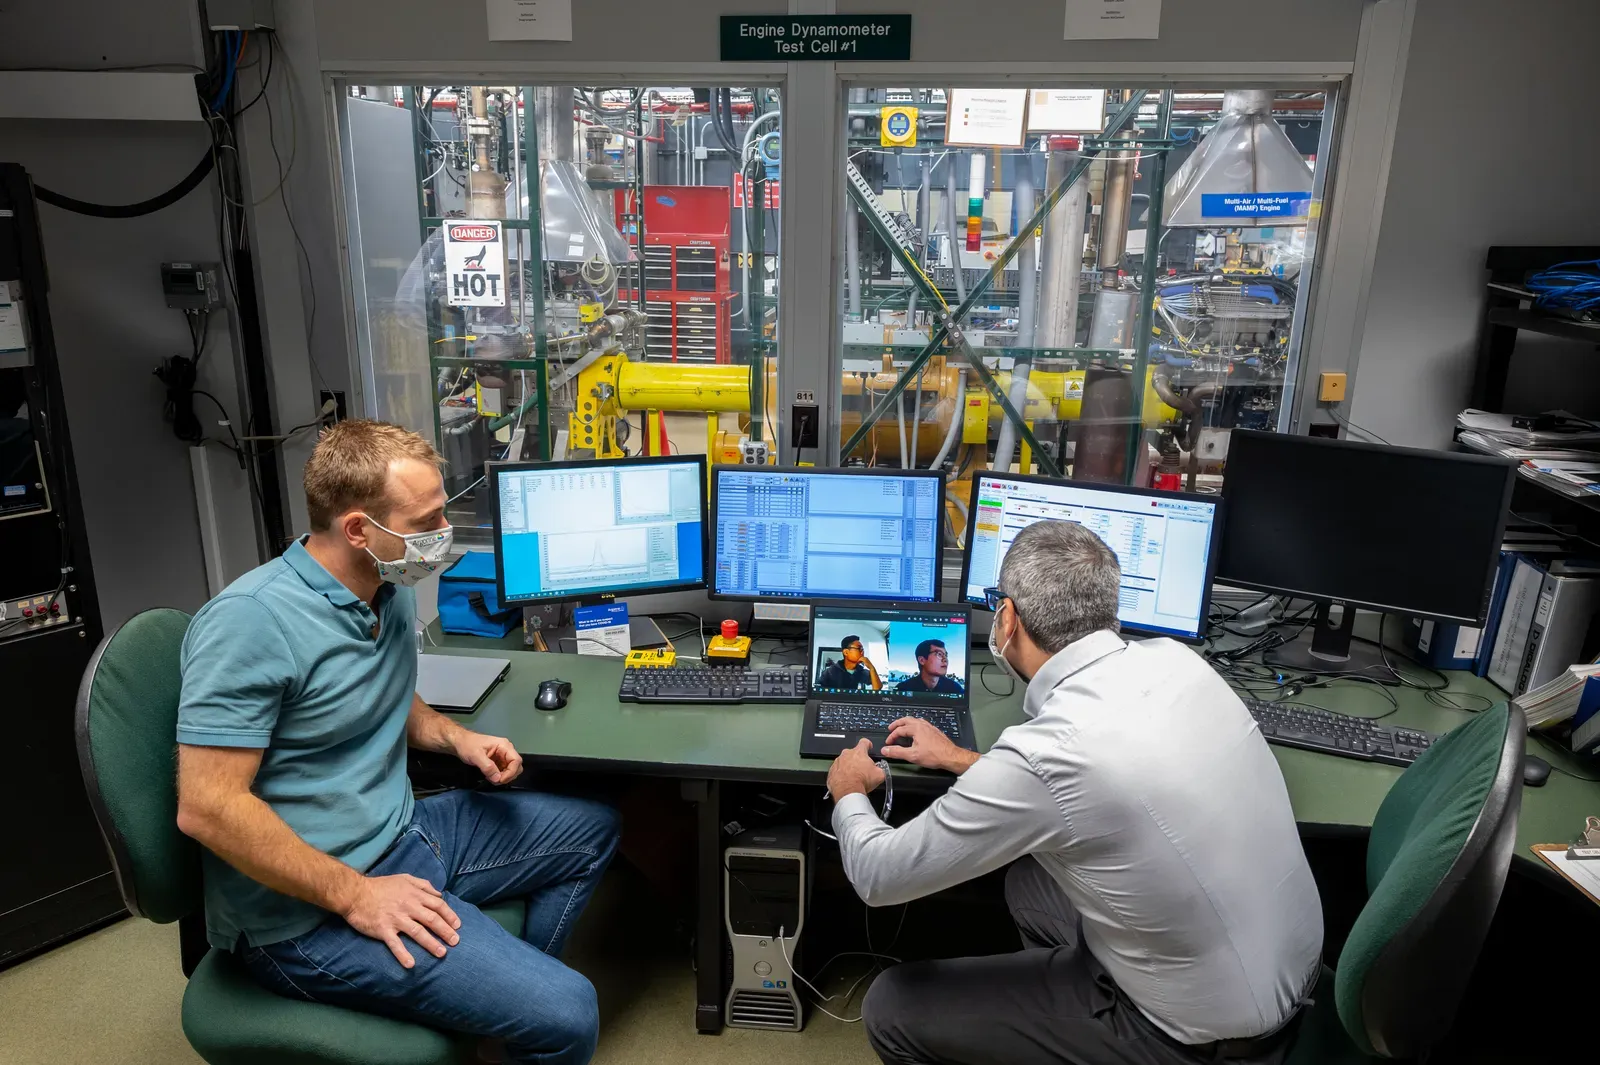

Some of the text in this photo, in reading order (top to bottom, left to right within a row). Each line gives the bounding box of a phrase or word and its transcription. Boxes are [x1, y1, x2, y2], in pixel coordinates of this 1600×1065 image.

[740, 23, 891, 39] Engine Dynamometer
[774, 40, 857, 53] Test Cell #1
[1234, 204, 1280, 212] (MAMF) Engine
[454, 228, 493, 238] DANGER
[453, 273, 501, 297] HOT
[1518, 643, 1537, 692] DIGALOG
